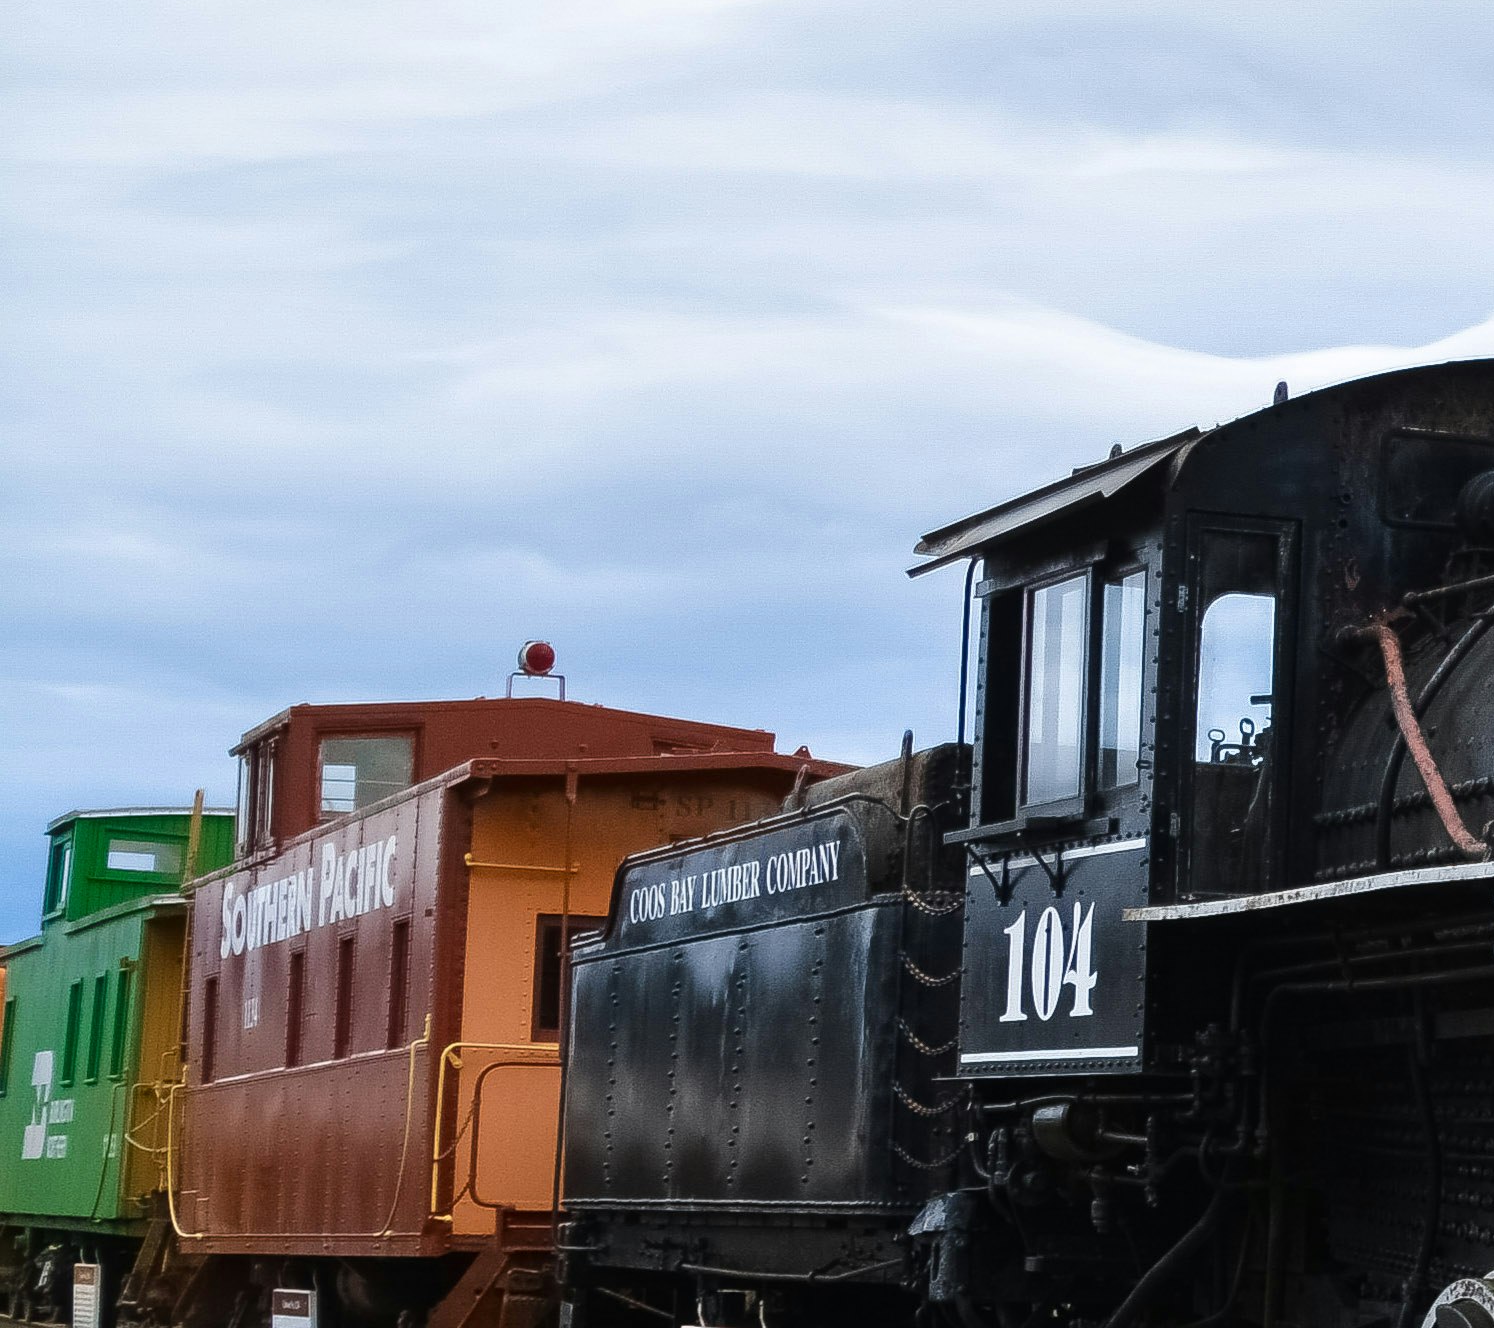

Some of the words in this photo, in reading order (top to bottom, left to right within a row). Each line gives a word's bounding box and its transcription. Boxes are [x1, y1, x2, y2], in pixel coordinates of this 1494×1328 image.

[220, 868, 314, 960] SOUTHERN
[318, 835, 396, 927] PACIFIC
[630, 883, 666, 924] COOS
[669, 875, 698, 916] BAY
[701, 860, 761, 909] LUMBER
[766, 840, 841, 895] COMPANY
[999, 901, 1098, 1023] 104
